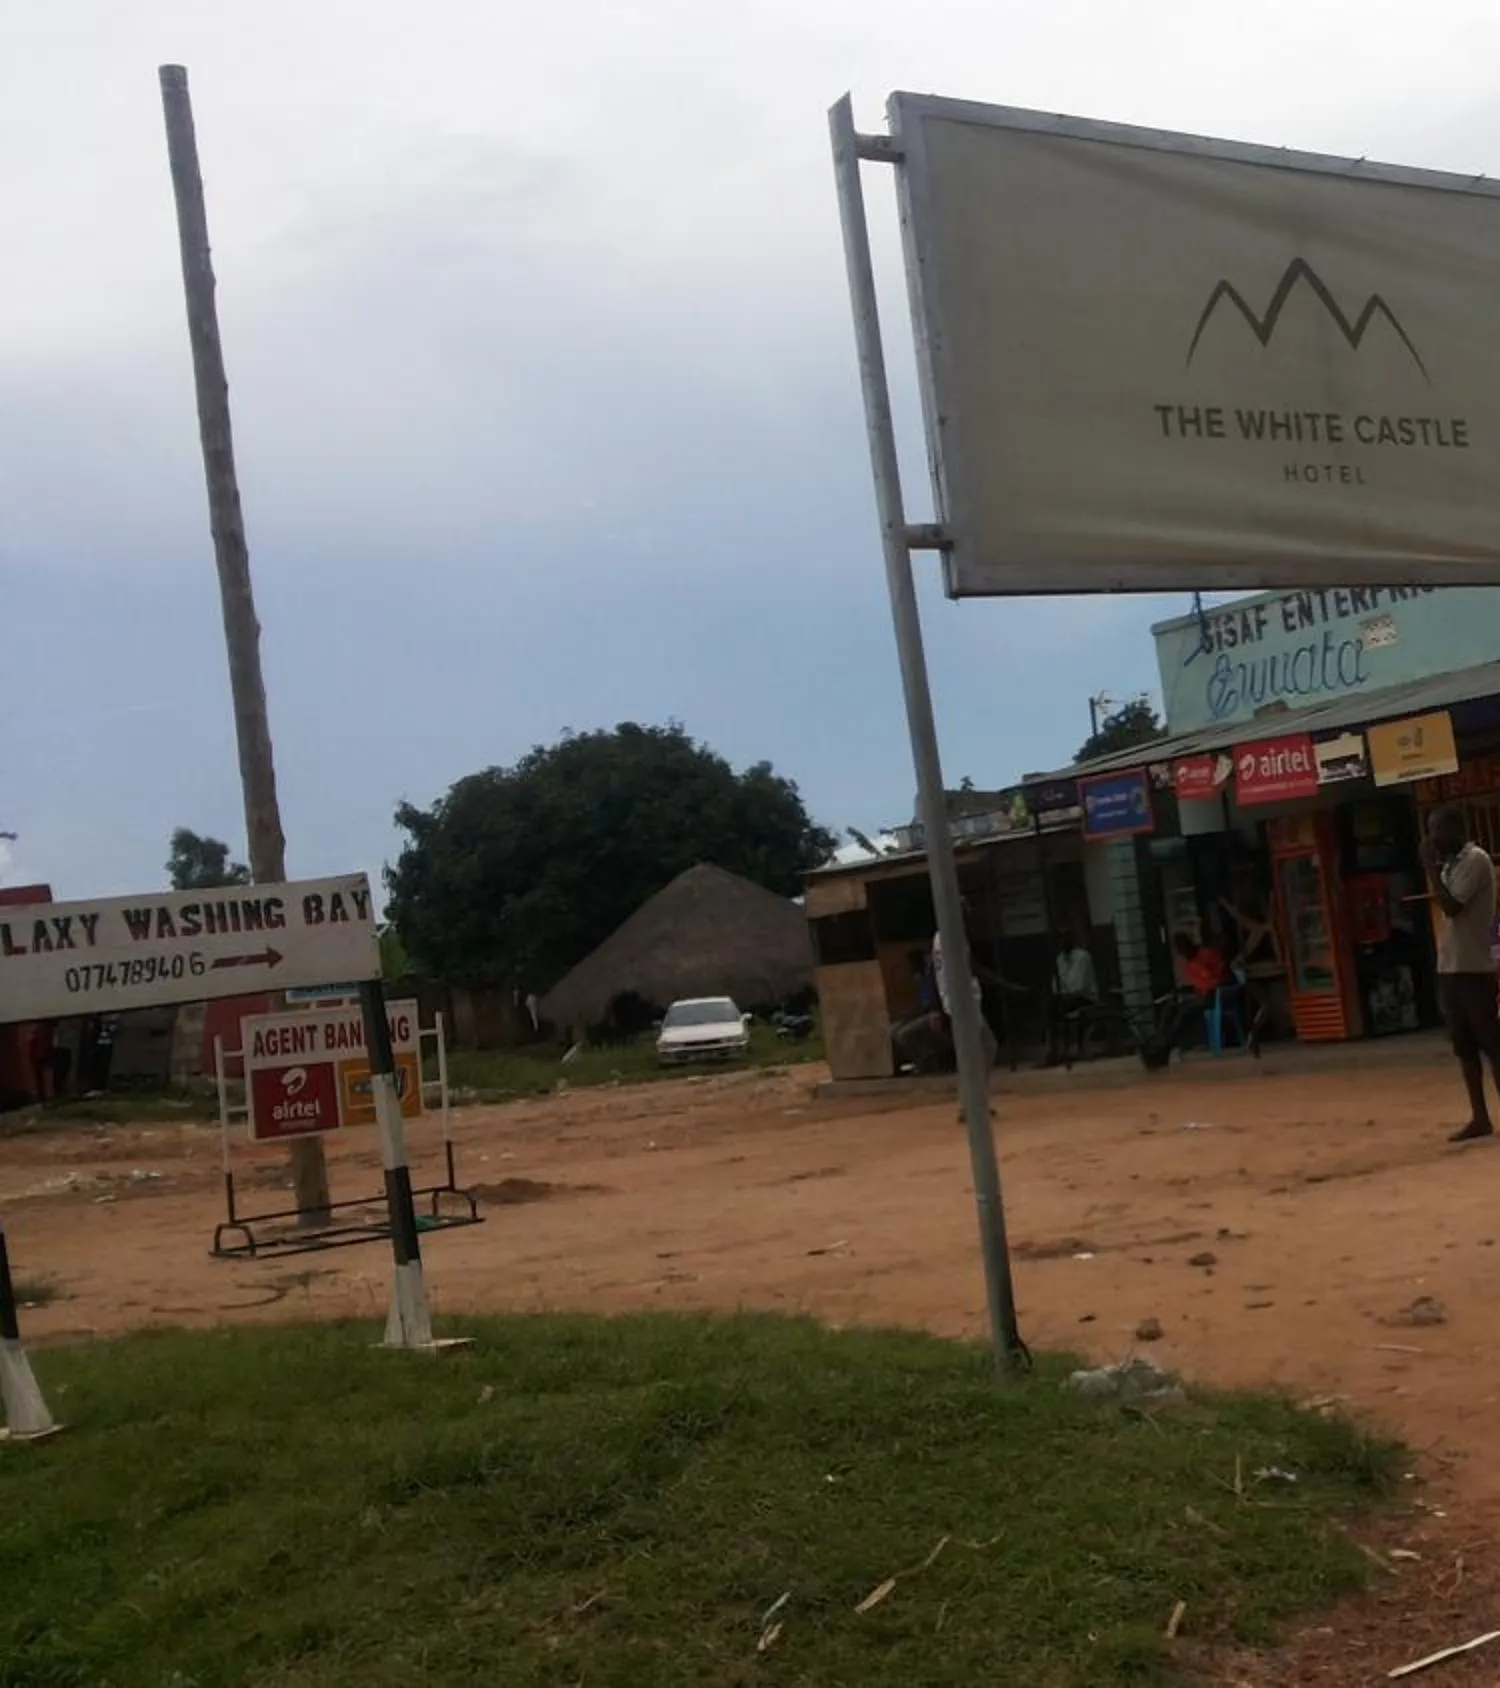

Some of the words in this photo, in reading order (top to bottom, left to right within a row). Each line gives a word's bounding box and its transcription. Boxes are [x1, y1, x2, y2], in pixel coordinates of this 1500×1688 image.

[1153, 404, 1227, 438] THE
[1235, 409, 1344, 442] WHITE
[1353, 415, 1470, 447] CASTLE
[1283, 463, 1367, 485] HOTEL
[1259, 745, 1312, 778] airtel
[0, 912, 99, 956] LAXY
[122, 897, 286, 942] WASHING
[303, 889, 370, 925] BAY
[65, 951, 205, 993] 0774789406
[252, 1023, 319, 1059] AGENT
[324, 1015, 410, 1049] BANG
[272, 1100, 321, 1120] airtel
